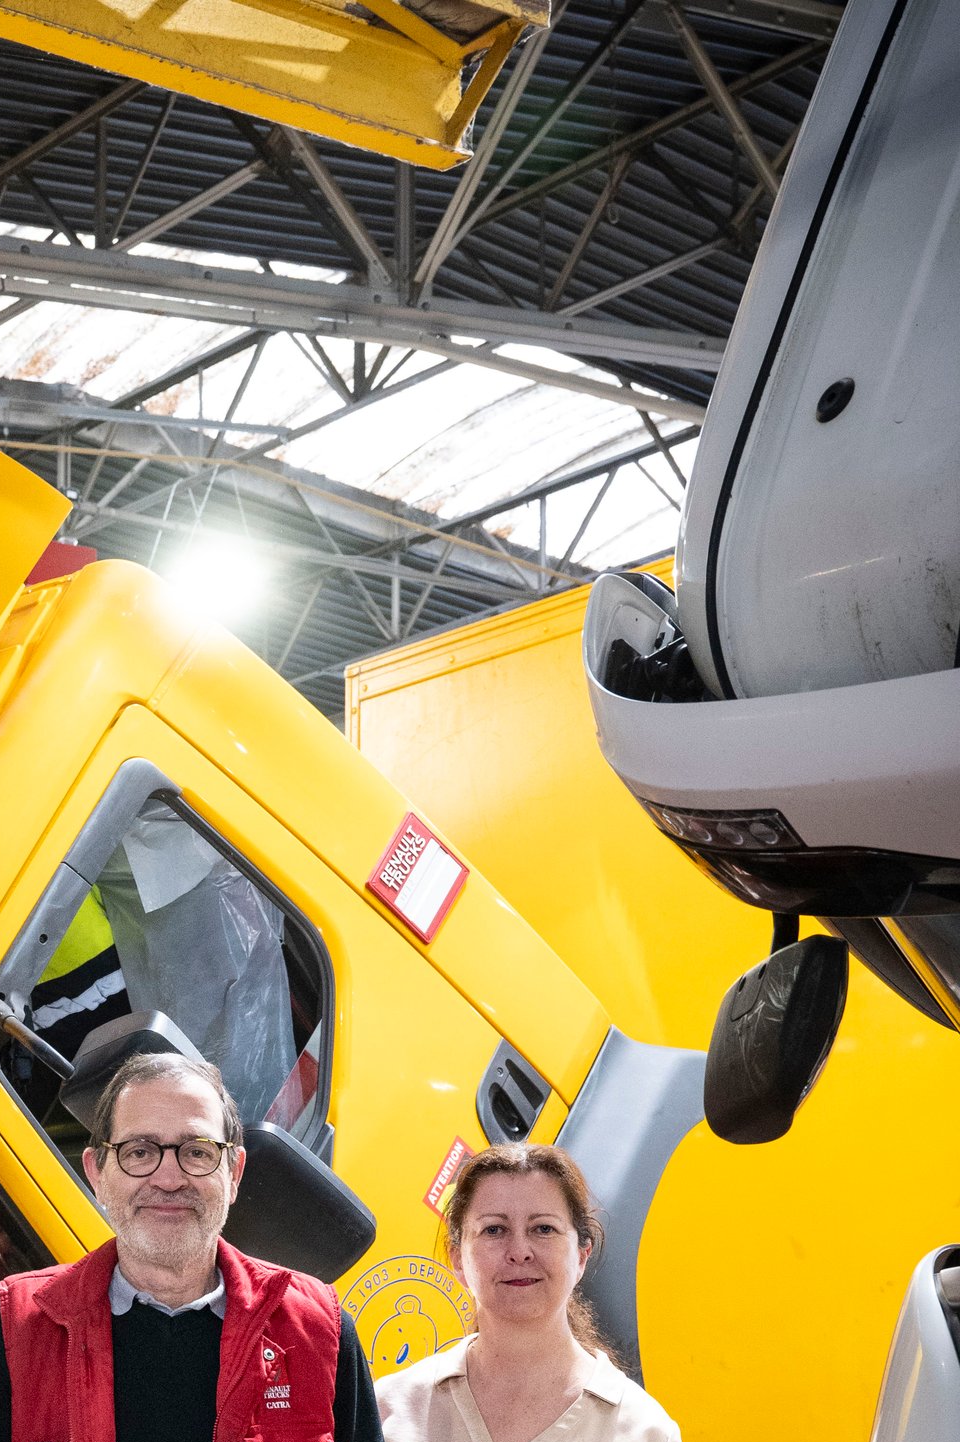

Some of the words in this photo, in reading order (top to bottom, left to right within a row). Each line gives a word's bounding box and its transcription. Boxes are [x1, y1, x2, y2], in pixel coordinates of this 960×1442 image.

[380, 825, 417, 886] RENAULT
[389, 834, 426, 891] TRUCKS
[427, 1141, 465, 1205] ATTENTION
[358, 1268, 389, 1298] 1903
[409, 1262, 455, 1293] DEPUIS
[456, 1292, 475, 1332] 190
[264, 1391, 290, 1399] TRUCKS
[266, 1401, 291, 1409] CATRA
